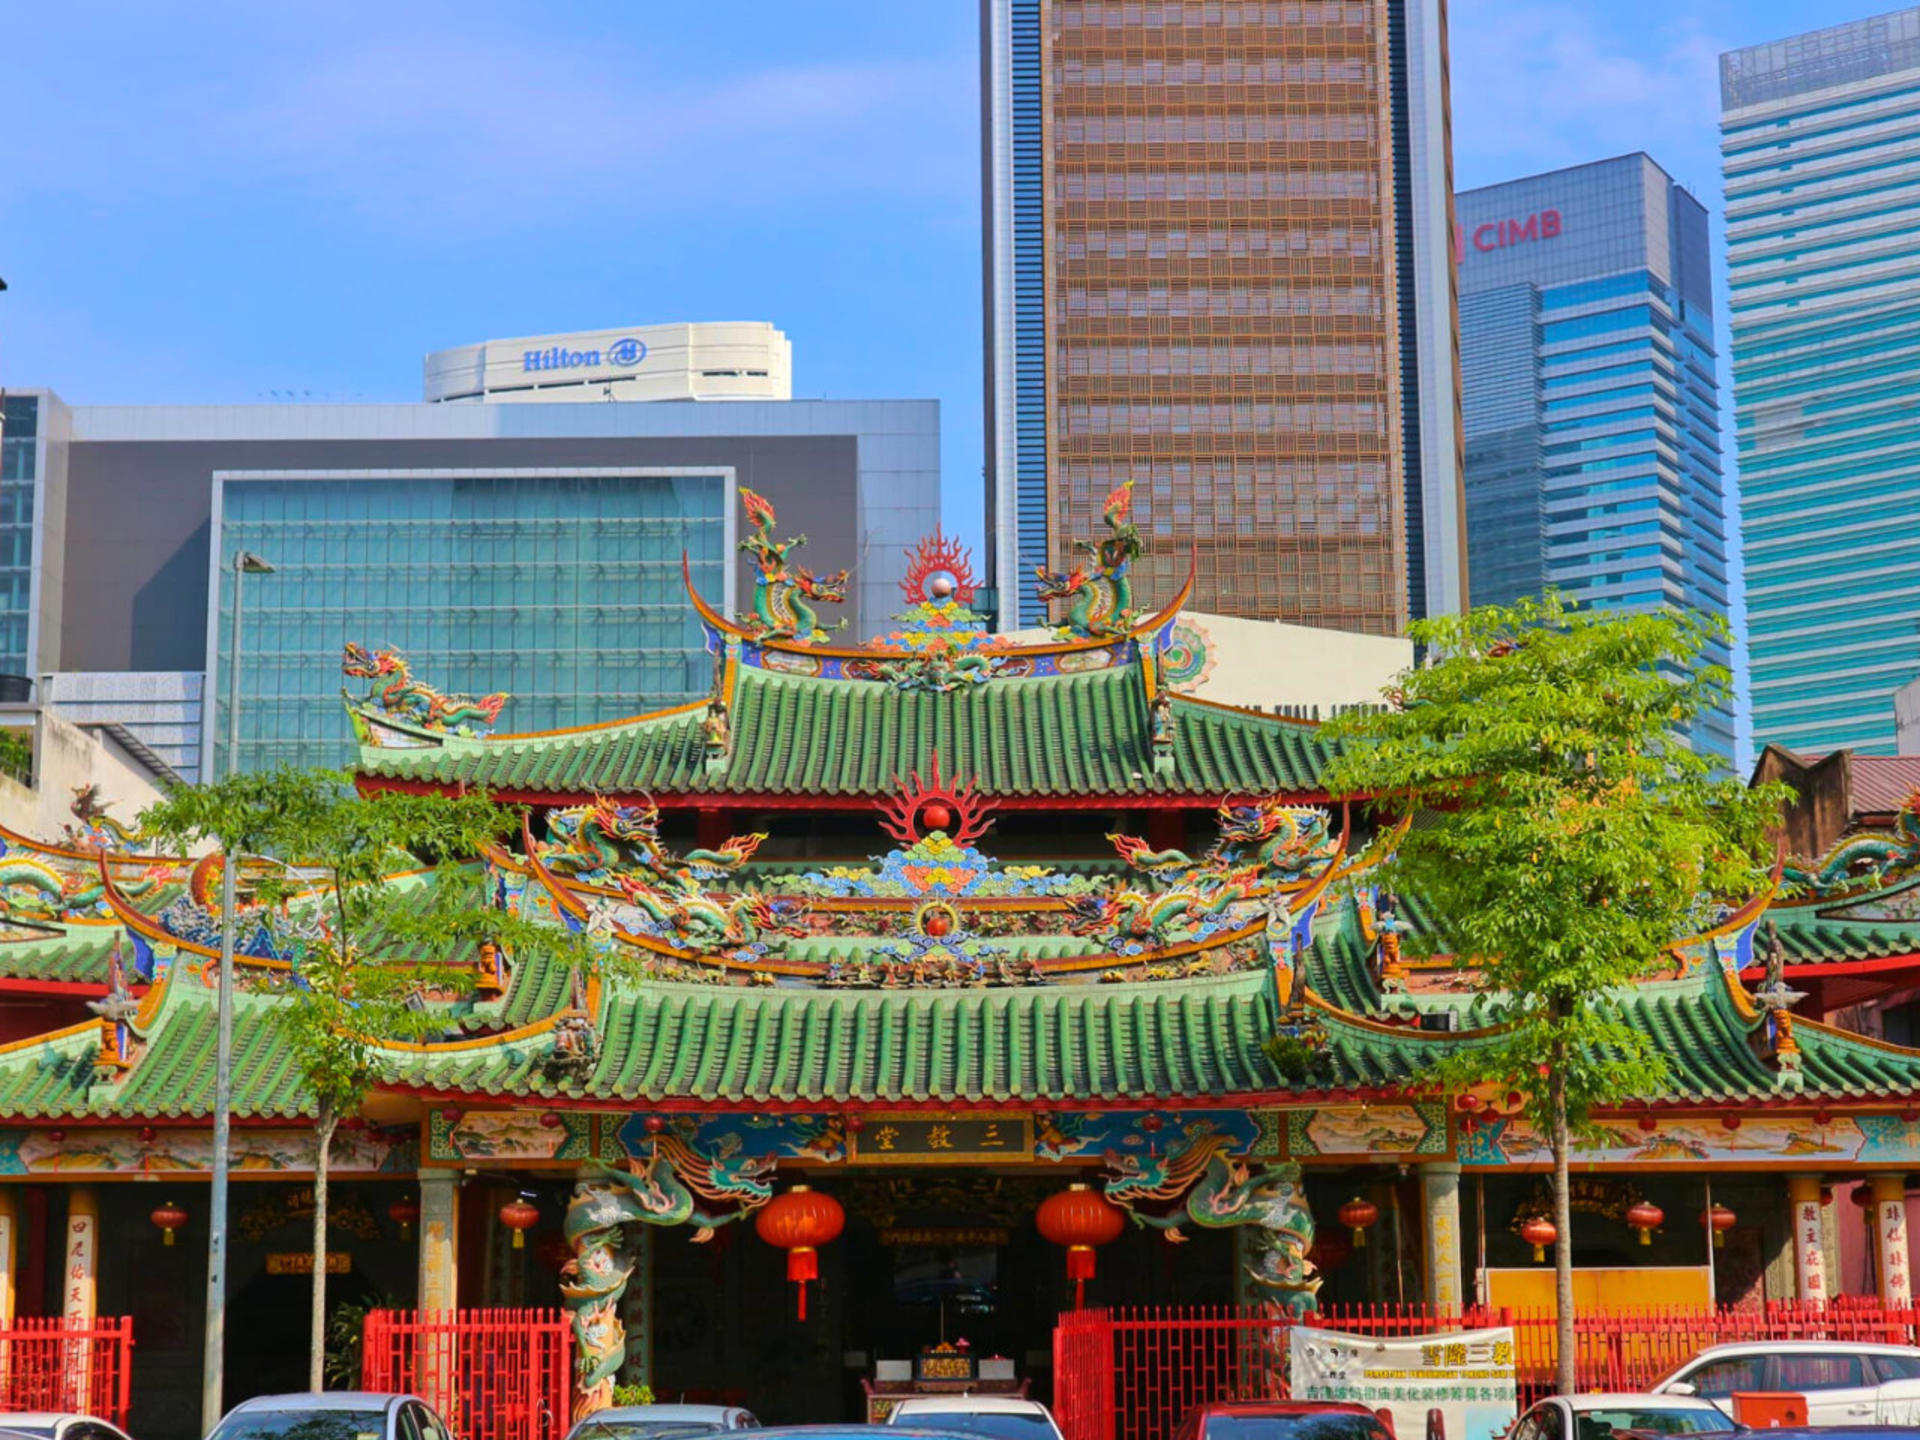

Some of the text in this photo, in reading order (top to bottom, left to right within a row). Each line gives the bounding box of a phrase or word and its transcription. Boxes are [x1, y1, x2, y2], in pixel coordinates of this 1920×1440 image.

[1473, 209, 1561, 252] CIMB
[523, 346, 600, 372] Hilton
[875, 1124, 1005, 1150] 三教堂
